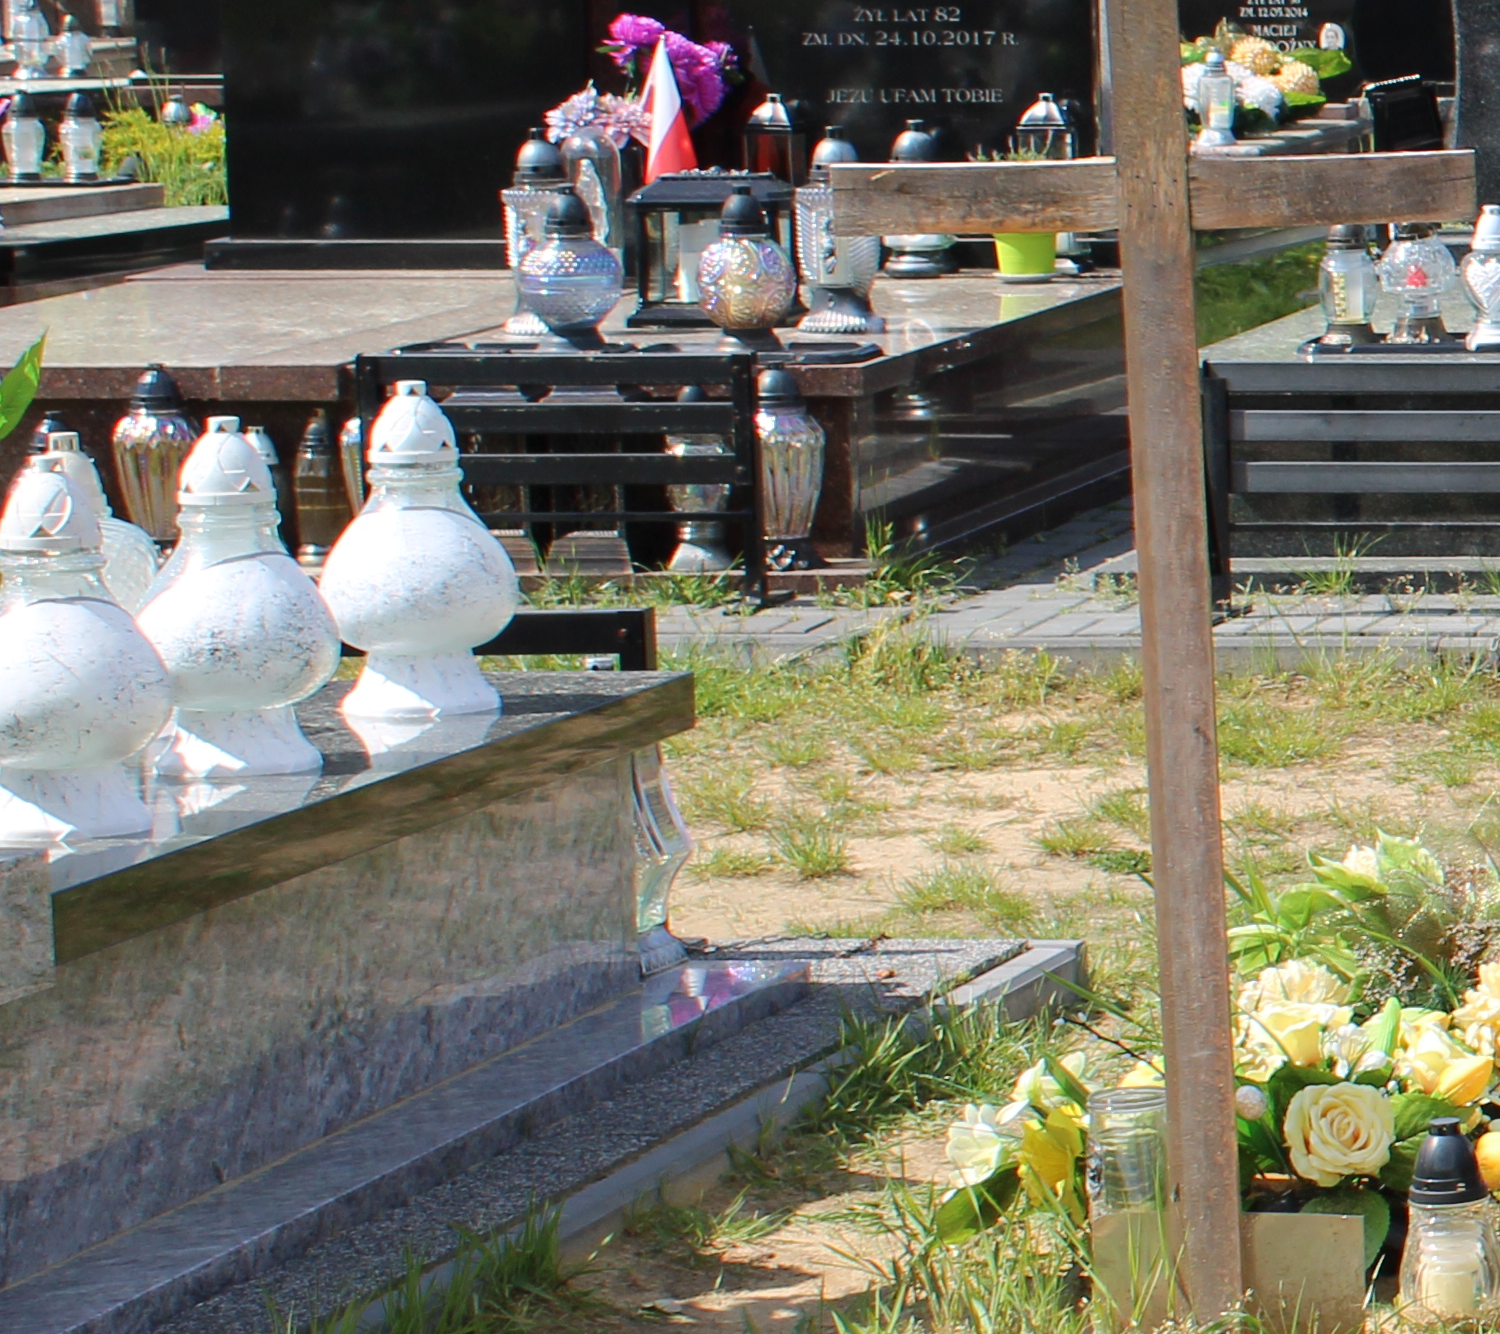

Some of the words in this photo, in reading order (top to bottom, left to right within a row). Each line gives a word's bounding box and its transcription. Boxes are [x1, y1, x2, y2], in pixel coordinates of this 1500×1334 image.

[893, 8, 929, 22] LAT
[934, 6, 961, 22] 82
[801, 32, 831, 46] ZM.
[838, 32, 869, 46] DN.
[875, 30, 996, 46] 24.10.2017
[1002, 32, 1019, 46] R.
[826, 88, 875, 104] JEZU
[880, 88, 936, 104] UFAM
[942, 88, 1004, 104] TOBIE
